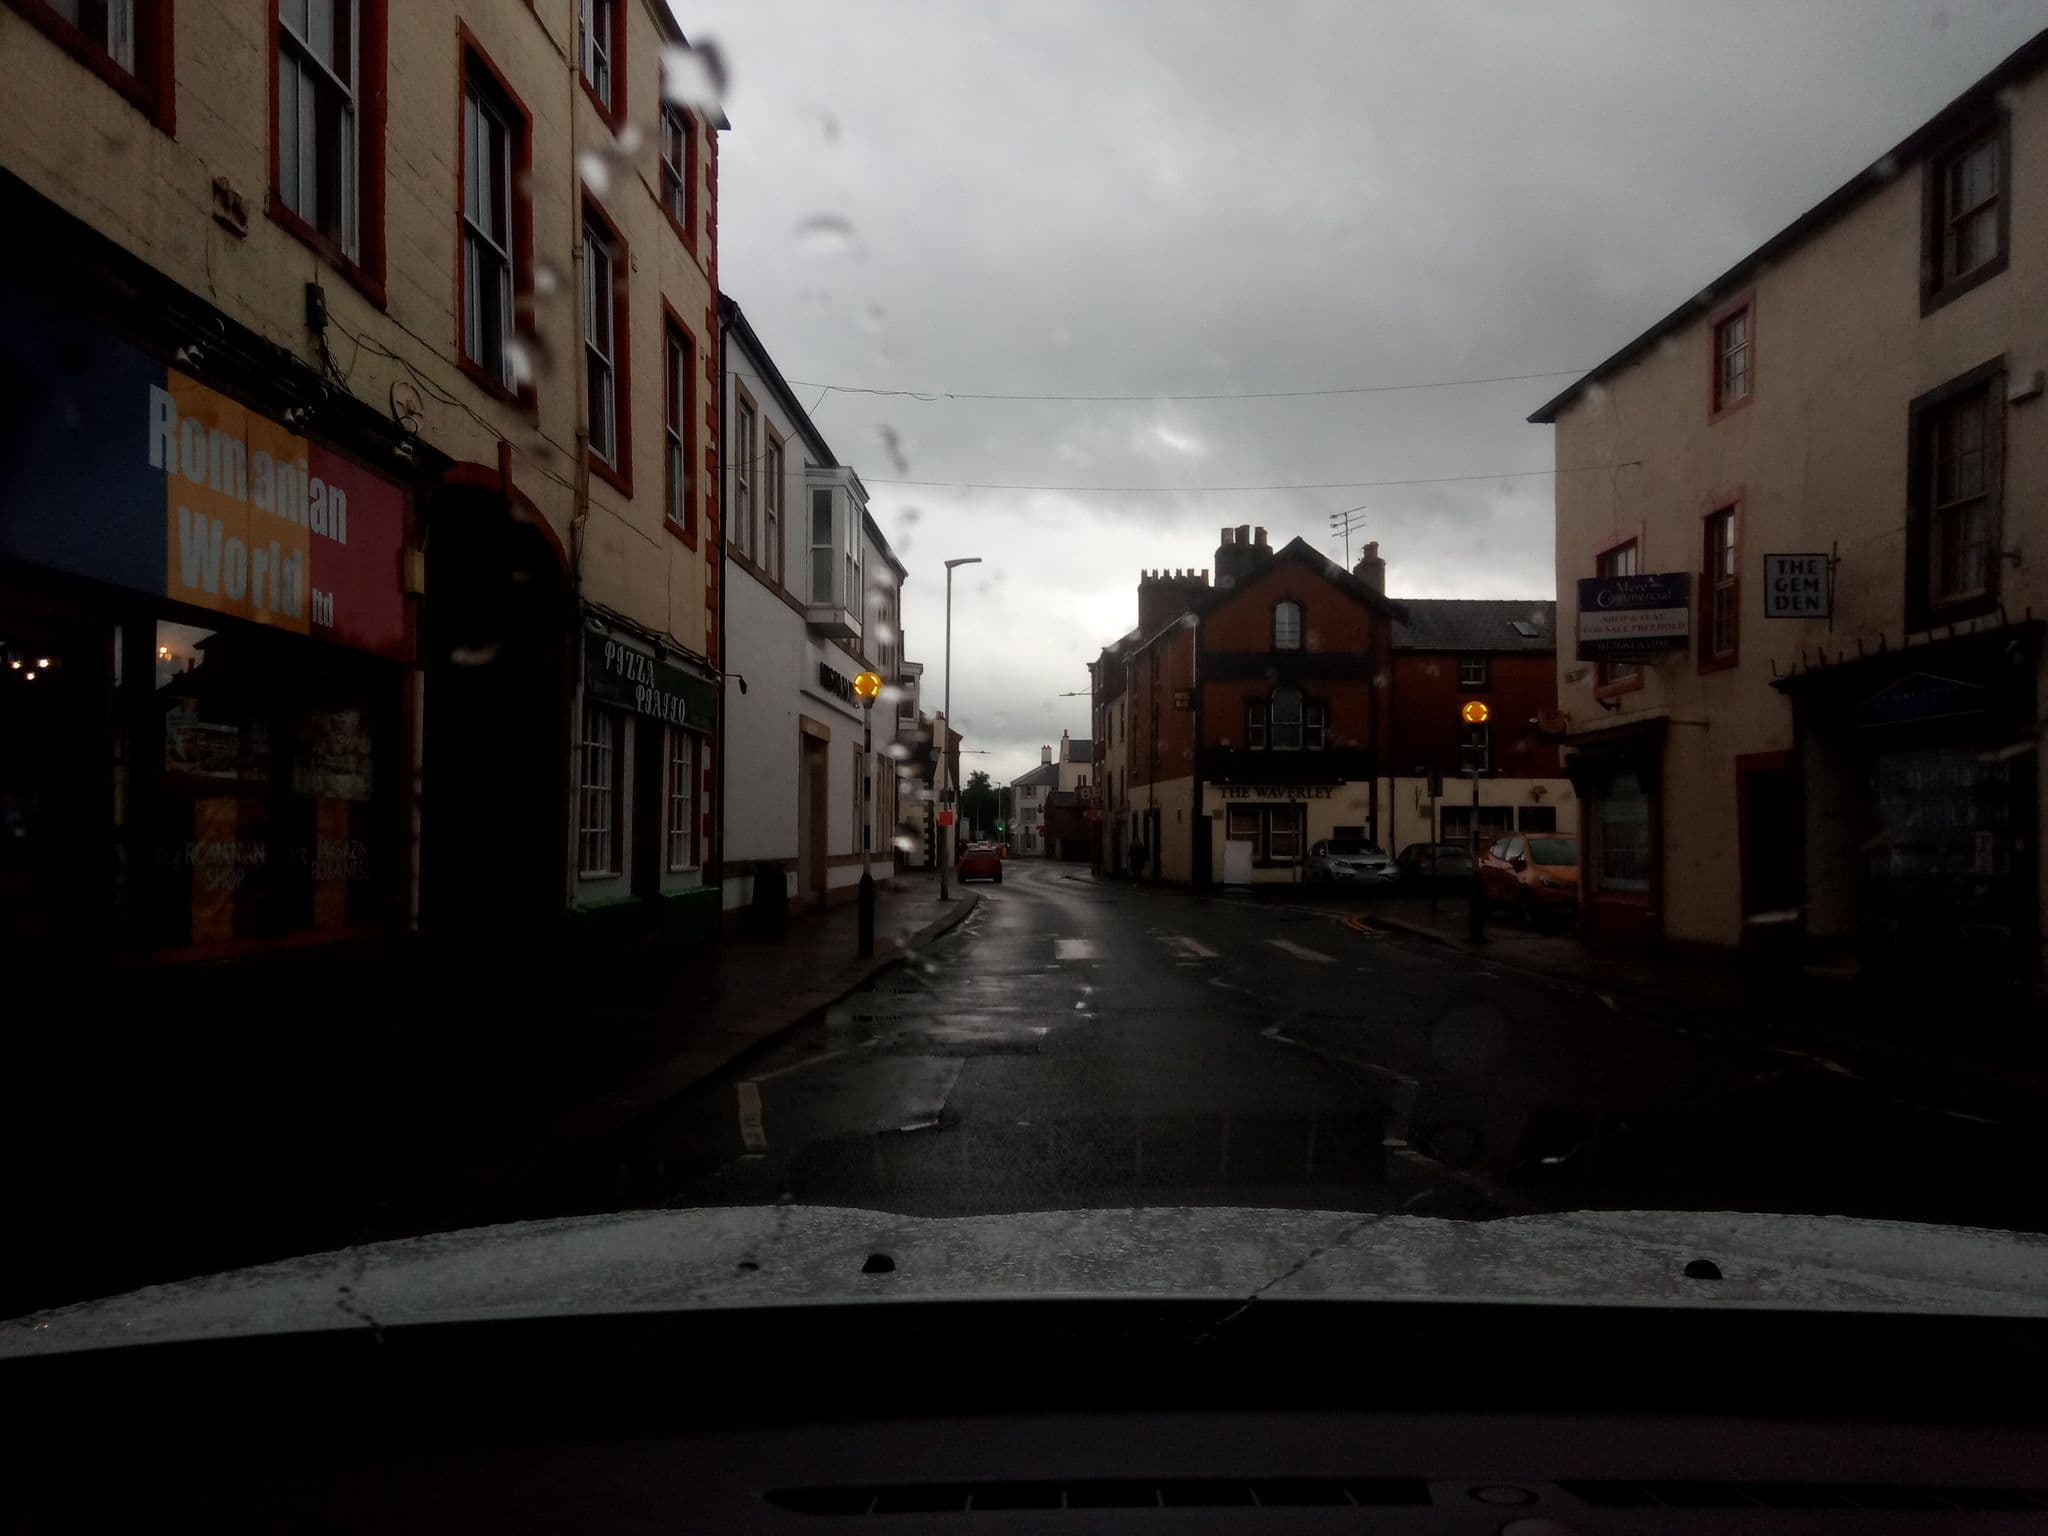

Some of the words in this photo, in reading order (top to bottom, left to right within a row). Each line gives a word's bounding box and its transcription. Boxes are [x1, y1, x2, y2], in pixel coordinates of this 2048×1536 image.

[149, 383, 347, 544] Romanian
[177, 505, 301, 618] World
[1776, 559, 1817, 575] THE
[1775, 577, 1819, 593] GEM
[1597, 587, 1672, 608] Commercial
[1775, 595, 1819, 610] DEN
[605, 640, 656, 690] PIZZA
[1220, 785, 1249, 799] THE
[1255, 784, 1333, 799] WAVERLEY
